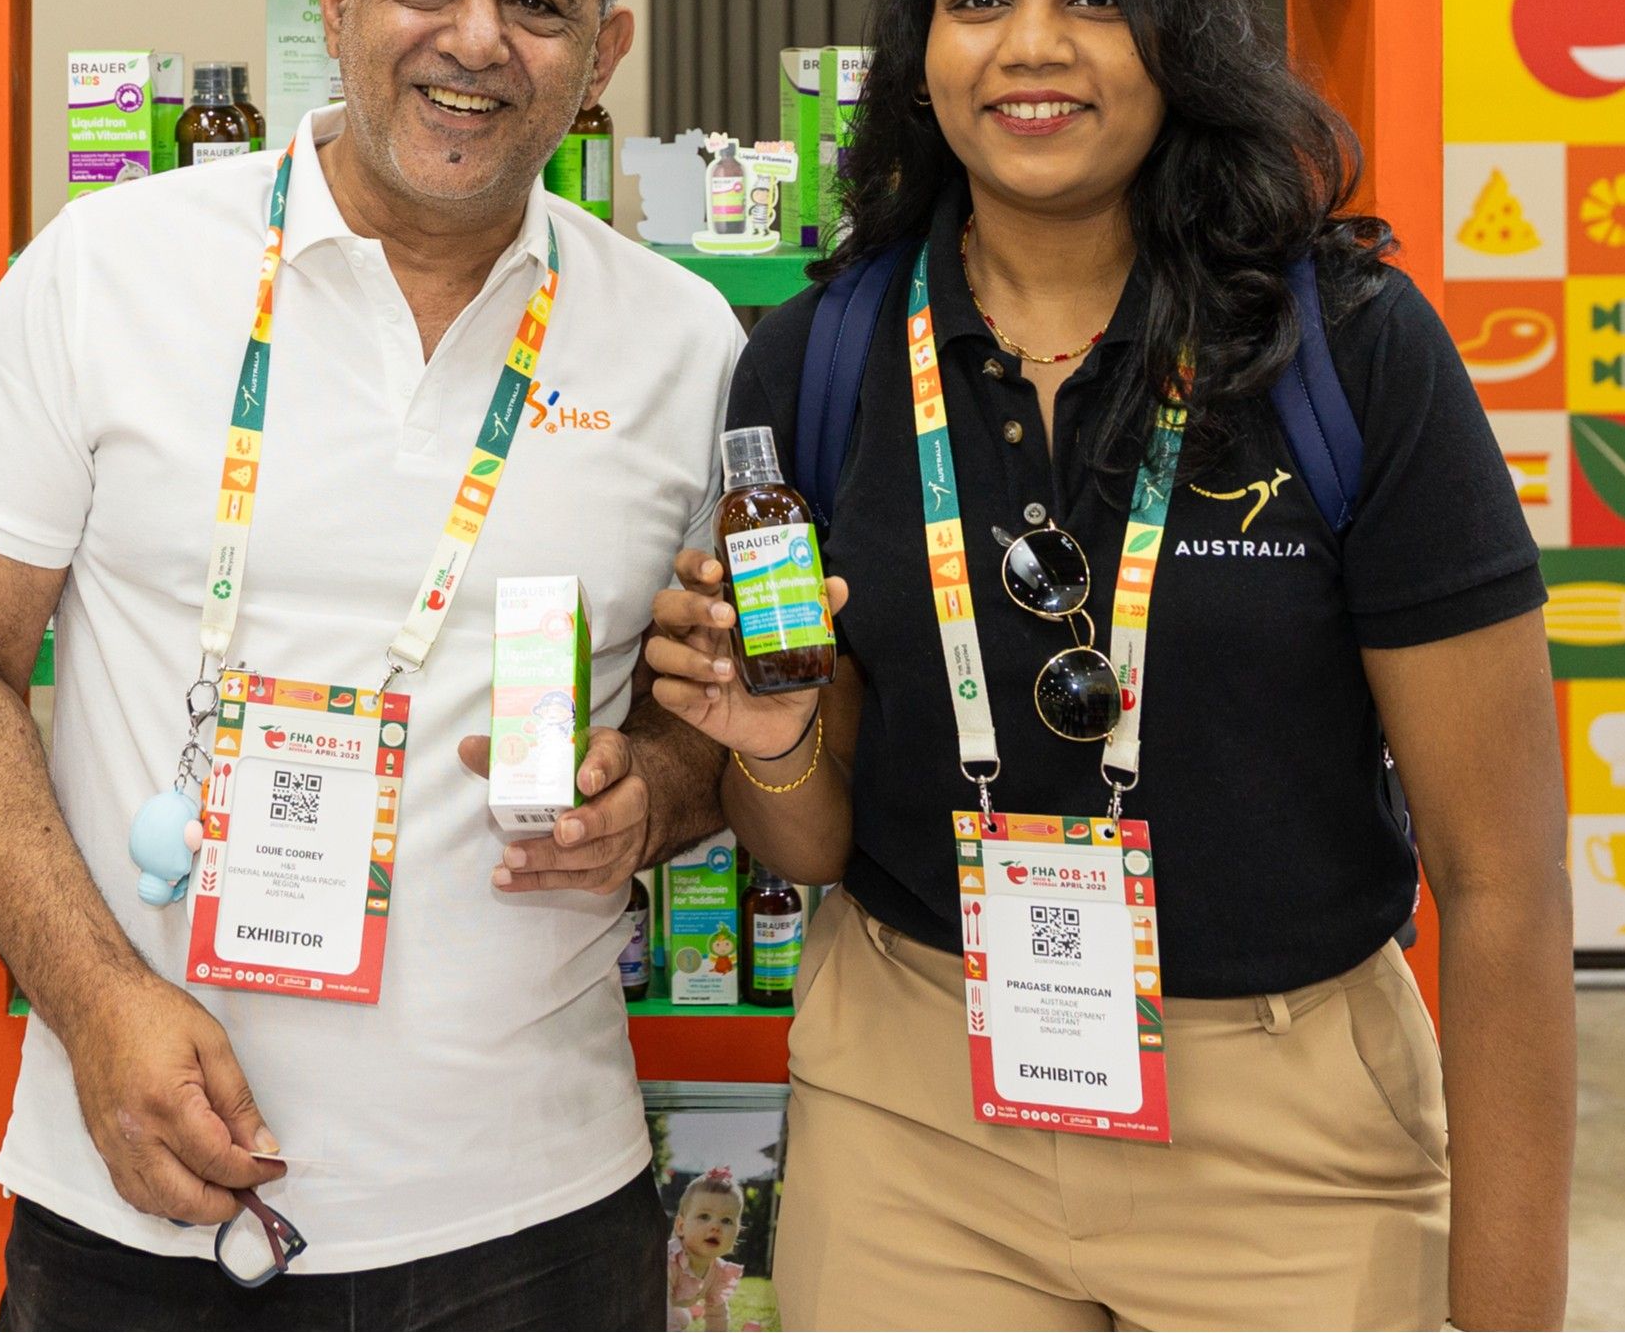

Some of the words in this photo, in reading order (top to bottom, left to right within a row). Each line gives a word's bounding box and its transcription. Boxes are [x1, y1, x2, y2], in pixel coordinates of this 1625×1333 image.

[71, 63, 126, 74] BRAUER
[72, 75, 100, 86] KIDS
[251, 351, 261, 394] AUSTRALIA
[504, 382, 521, 423] AUSTRALIA
[560, 408, 611, 430] H&S
[936, 440, 945, 483] AUSTRALIA
[730, 533, 780, 553] BRAUER
[1176, 539, 1306, 558] AUSTRALIA
[733, 551, 757, 564] KIDS
[737, 583, 764, 597] Liquid
[289, 732, 313, 744] FHA
[315, 749, 338, 757] APRIL
[340, 752, 360, 760] 2025
[256, 845, 283, 856] LOUIE
[285, 848, 324, 861] COOREY
[228, 866, 260, 876] GENERAL
[319, 877, 347, 887] PACIFIC
[1032, 866, 1056, 877] FHA
[236, 925, 324, 948] EXHIBITOR
[1006, 980, 1053, 993] PRAGASE
[1054, 985, 1112, 998] KOMARGAN
[1040, 998, 1078, 1008] AUSTRADE
[1014, 1006, 1050, 1016] BUSINESS
[1051, 1009, 1106, 1021] DEVELOPMENT
[1040, 1016, 1080, 1026] ASSISTANT
[1039, 1026, 1081, 1036] SINGAPORE
[1019, 1063, 1109, 1087] EXHIBITOR
